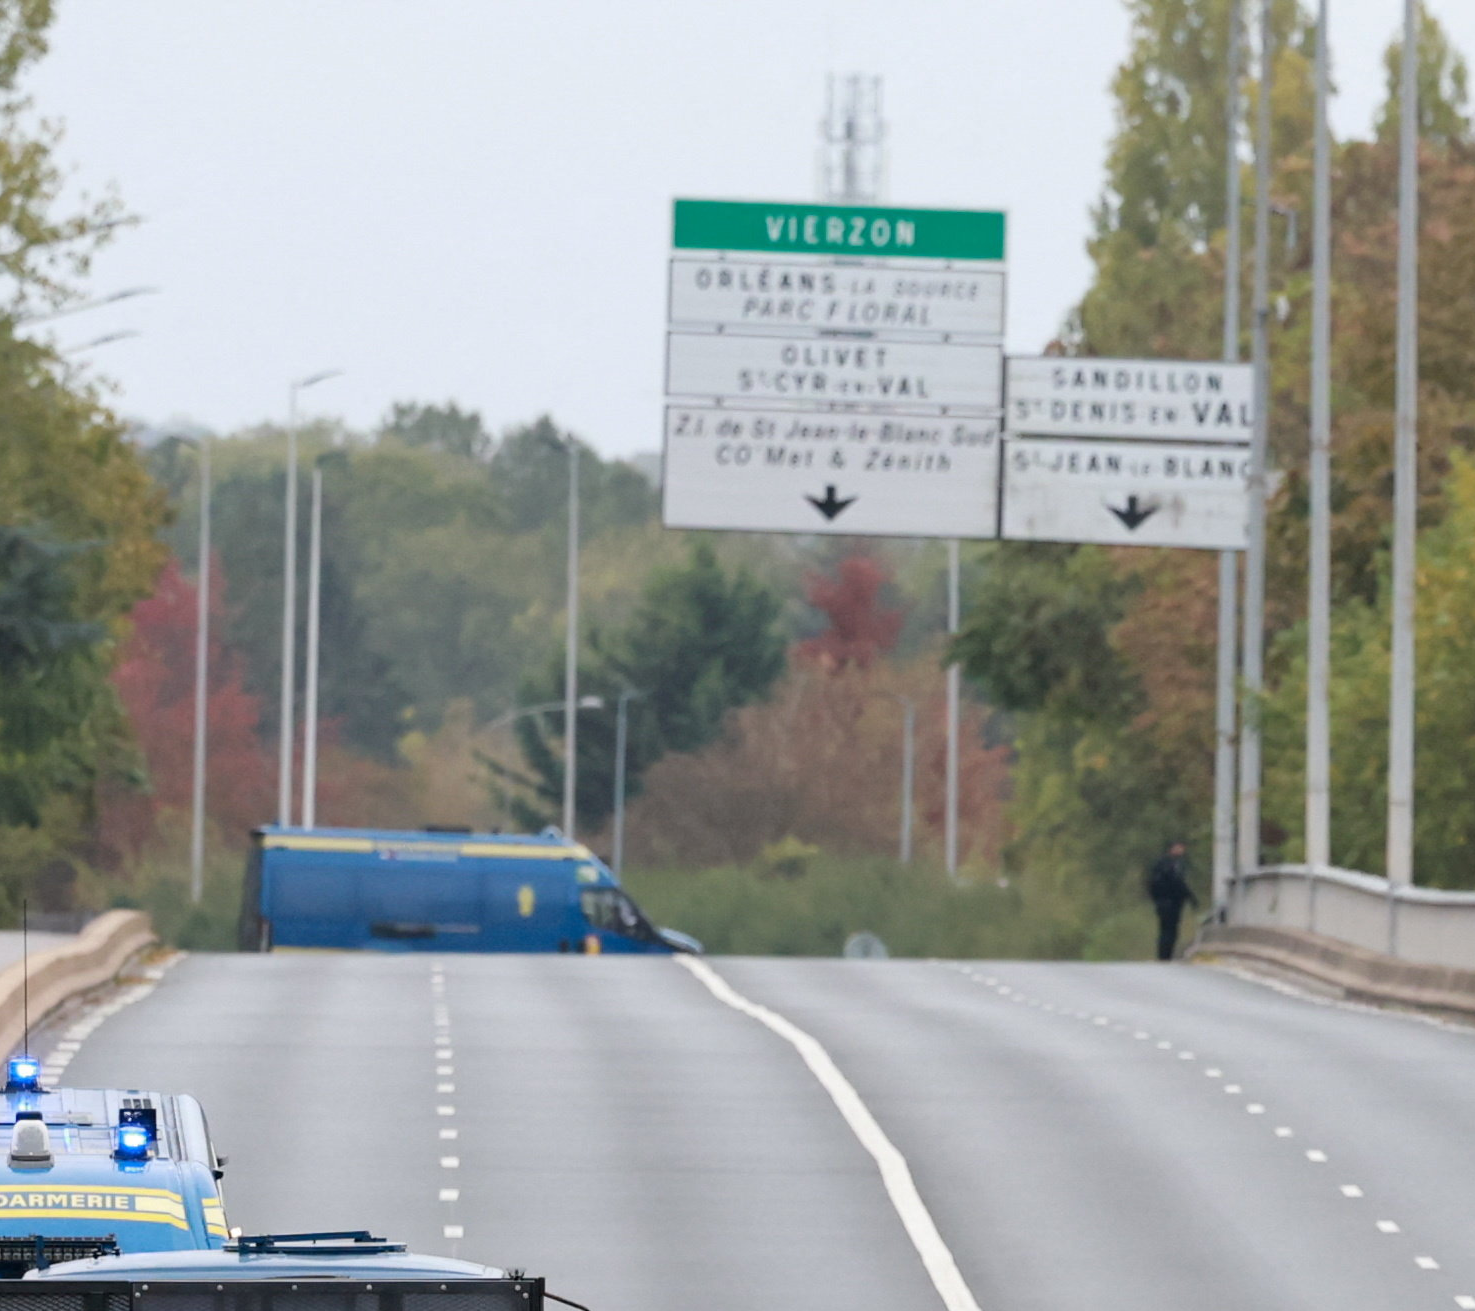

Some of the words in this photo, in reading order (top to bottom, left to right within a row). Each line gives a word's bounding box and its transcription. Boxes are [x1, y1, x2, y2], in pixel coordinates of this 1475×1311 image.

[765, 215, 916, 245] VIERZON
[694, 267, 836, 295] ORLÉANS
[893, 280, 979, 301] SOURCE
[742, 298, 812, 321] PARC
[822, 300, 930, 325] FLORAL
[780, 344, 887, 369] OLIVET
[1051, 366, 1223, 393] SANDILLON
[715, 417, 744, 437] de
[949, 424, 996, 447] Sud
[828, 447, 846, 470] &
